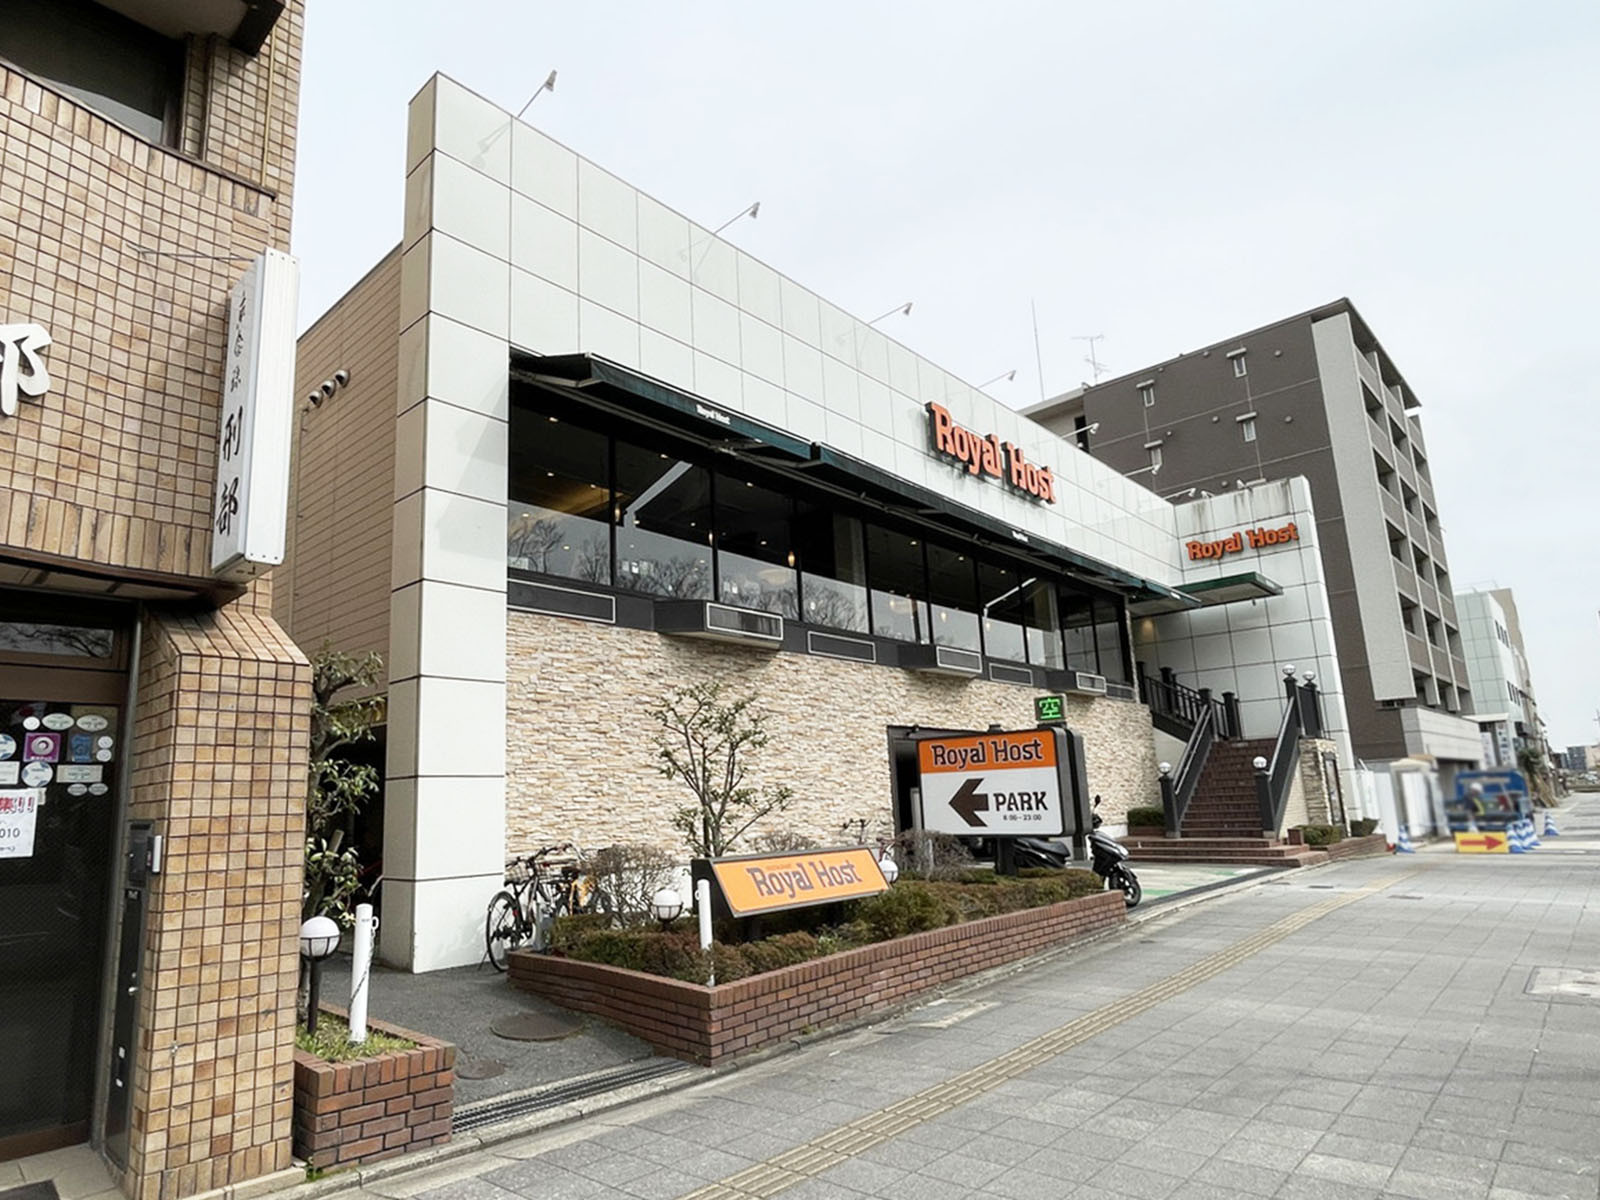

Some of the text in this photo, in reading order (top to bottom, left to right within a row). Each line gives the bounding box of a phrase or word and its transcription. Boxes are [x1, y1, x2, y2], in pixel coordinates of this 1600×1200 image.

[925, 401, 1056, 505] Royal Host
[1186, 522, 1299, 560] Royal Host
[1039, 697, 1061, 719] 空
[931, 739, 1043, 769] Royal Host
[993, 791, 1048, 811] PARK
[746, 860, 863, 897] Royal Host
